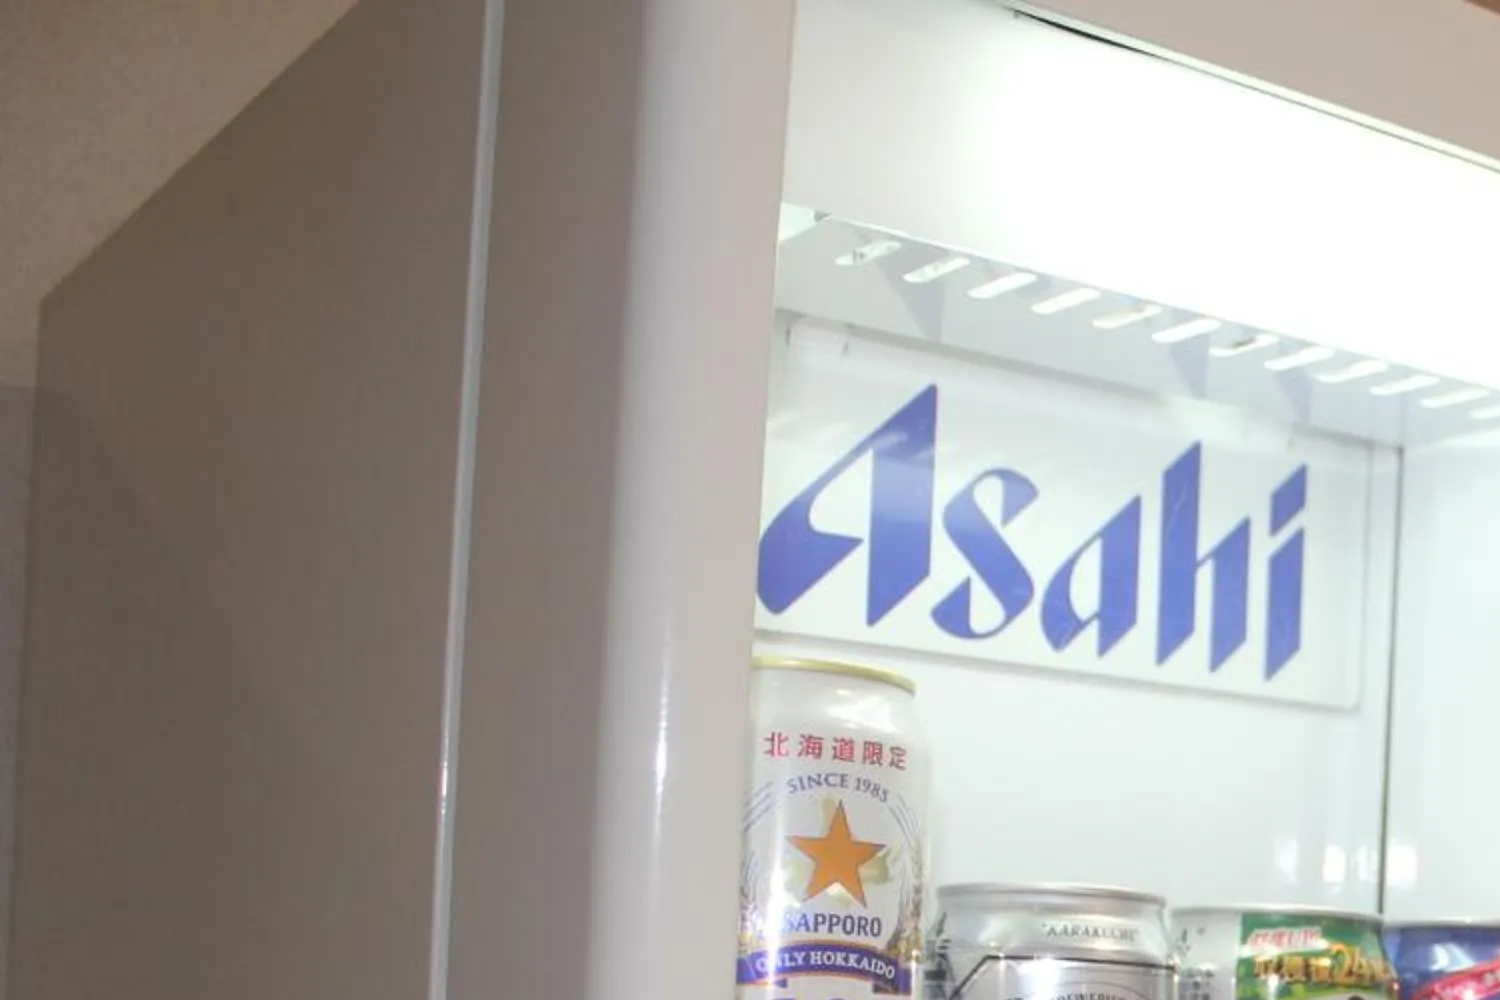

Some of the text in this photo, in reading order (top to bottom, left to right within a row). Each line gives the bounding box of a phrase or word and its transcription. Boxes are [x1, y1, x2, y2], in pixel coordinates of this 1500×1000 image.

[757, 383, 1307, 681] Asahi
[764, 732, 907, 770] 北海道限定
[786, 773, 849, 794] SINCE
[781, 913, 882, 937] SAPPORO
[810, 951, 896, 979] HOKKAIDO
